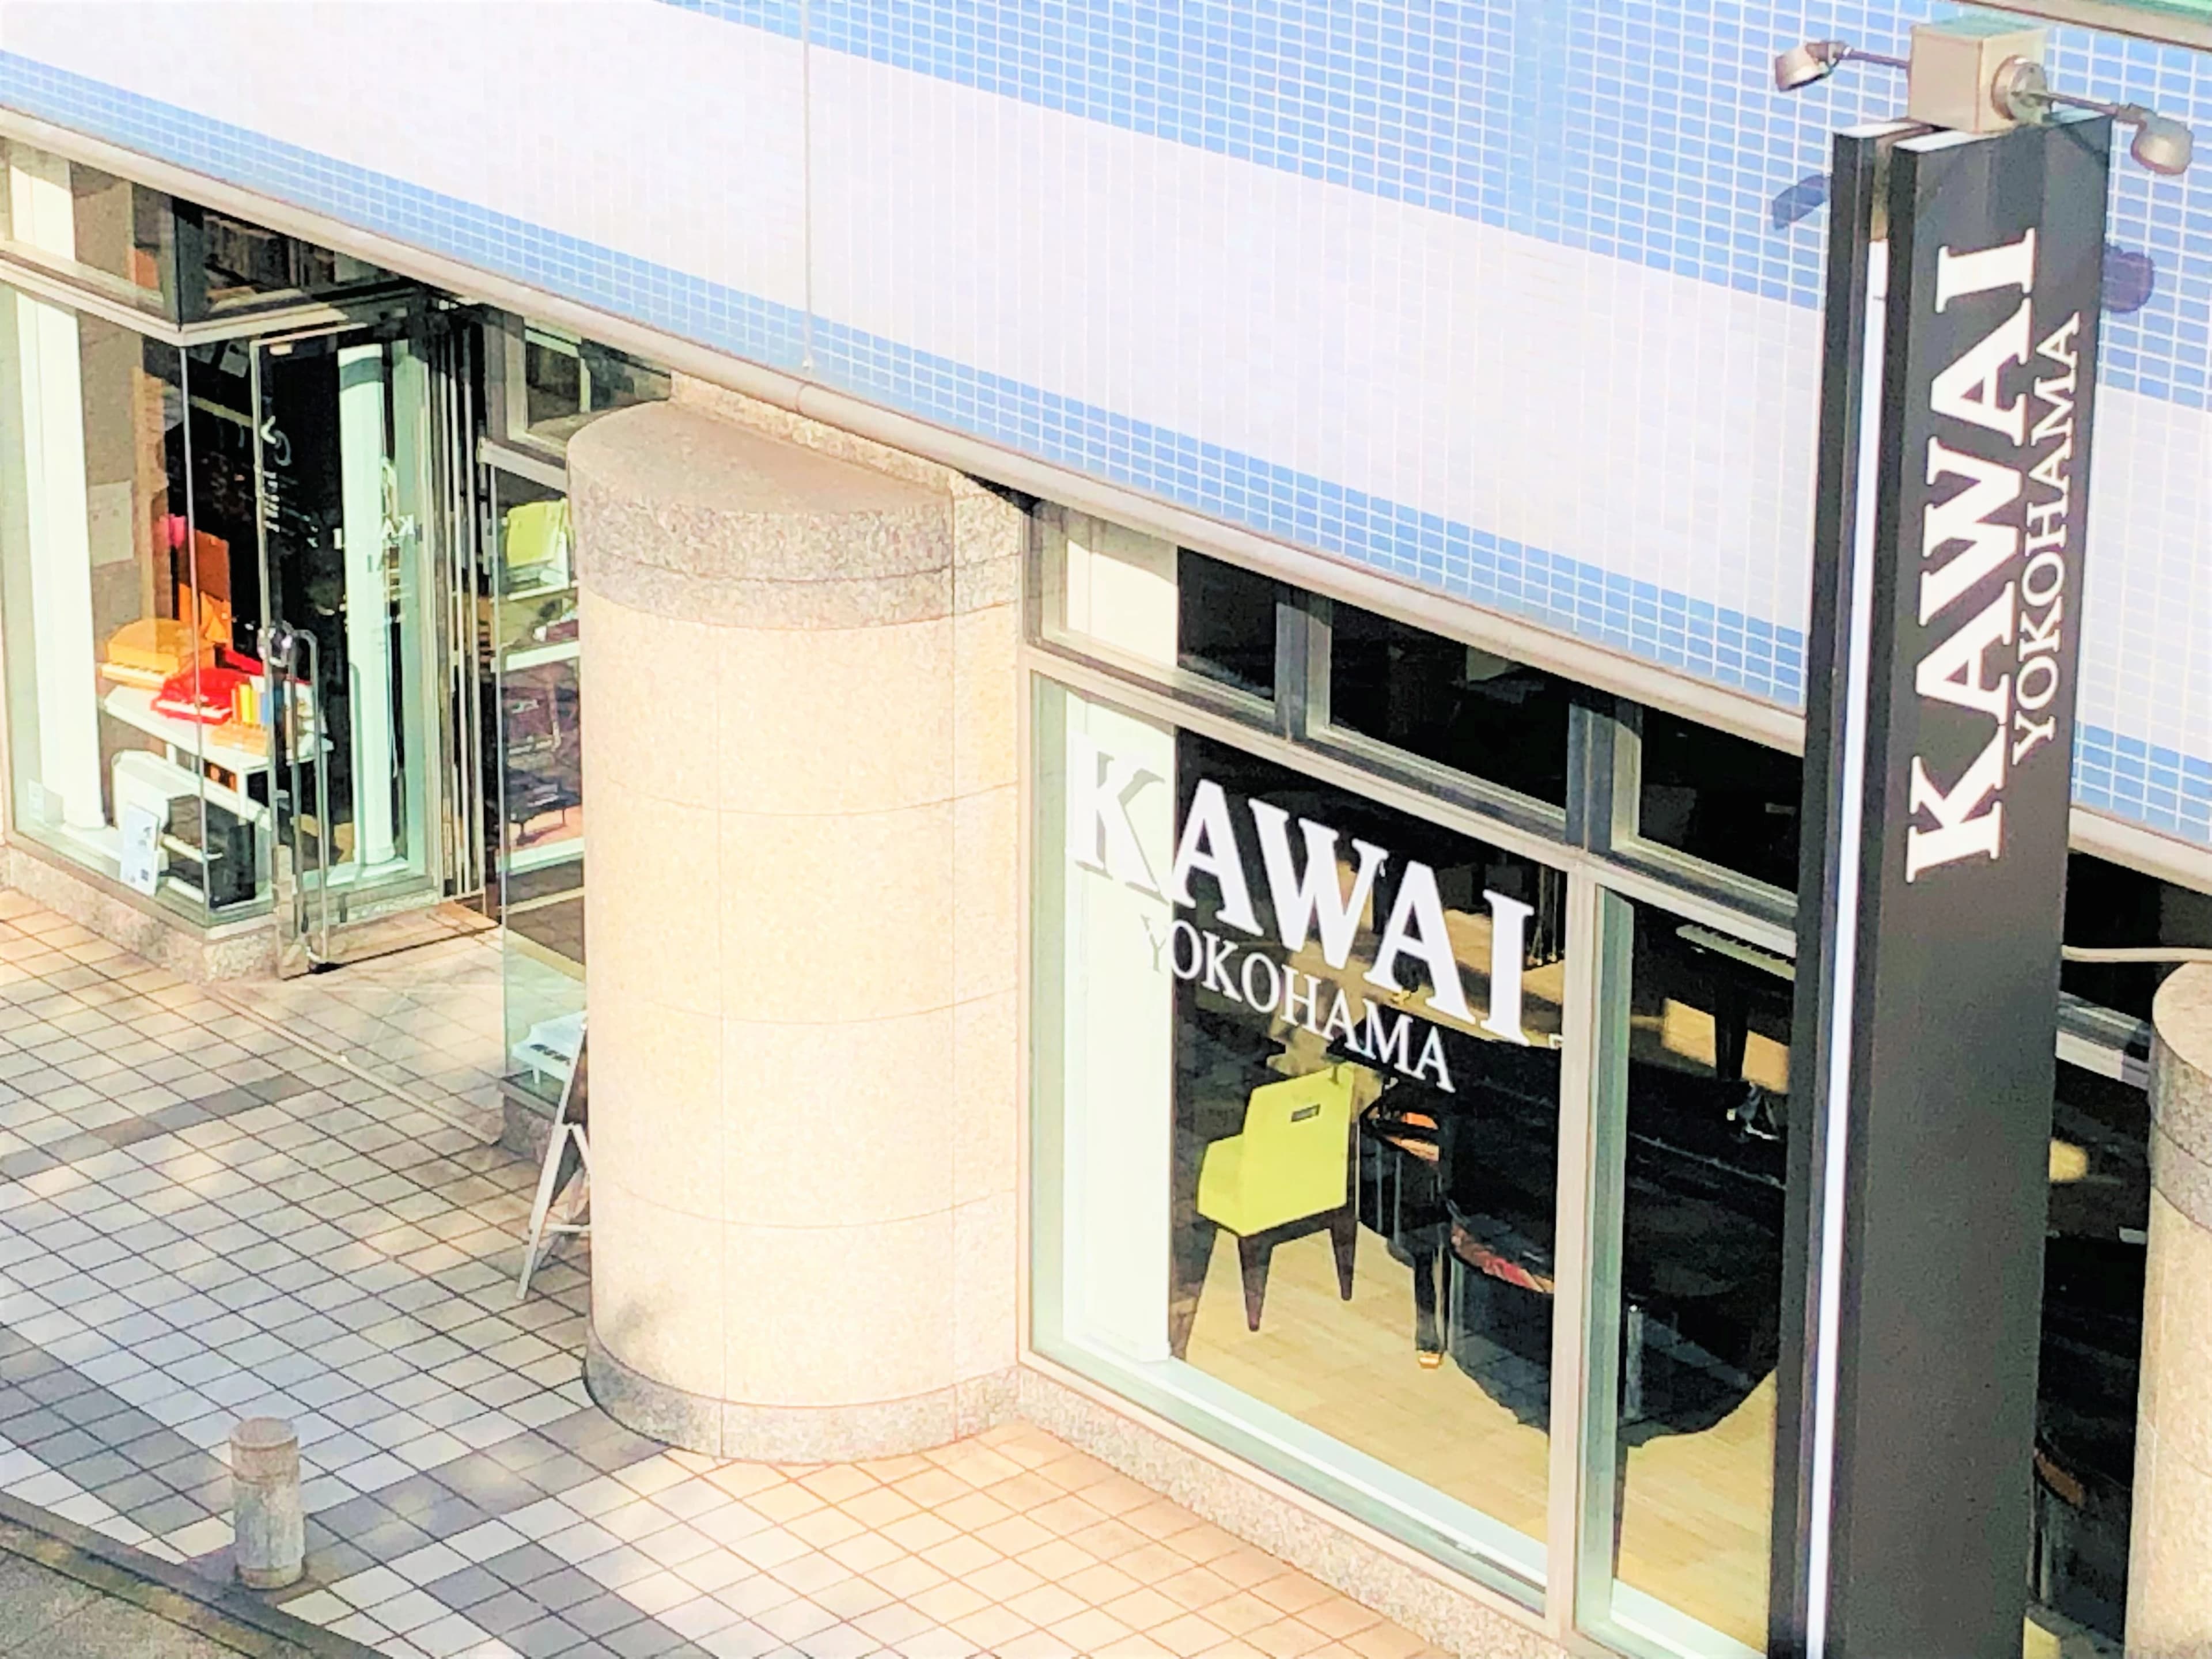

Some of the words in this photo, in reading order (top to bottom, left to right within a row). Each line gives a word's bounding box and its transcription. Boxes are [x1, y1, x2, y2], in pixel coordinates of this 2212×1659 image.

[1906, 228, 2036, 884] KAWAI
[2012, 311, 2080, 766] YOKOHAMA
[1065, 730, 1535, 1047] KAWAI
[1141, 914, 1456, 1094] YOKOHAMA
